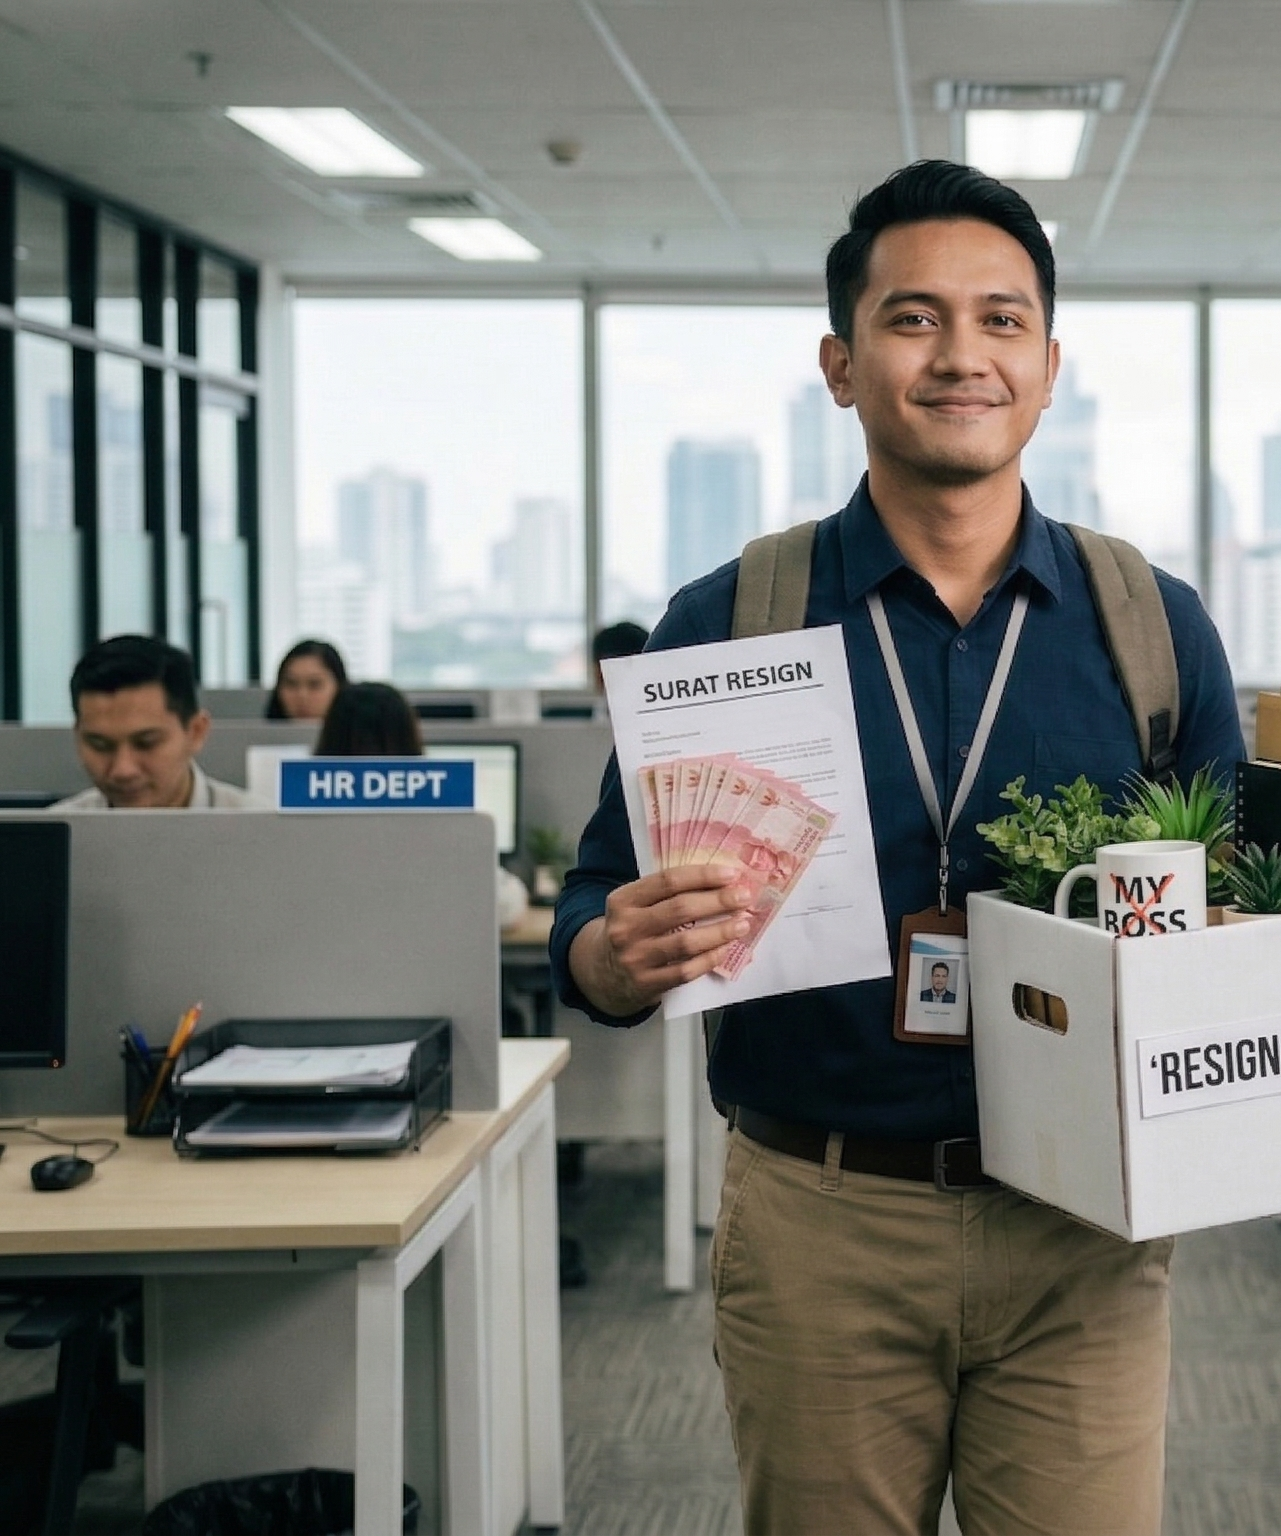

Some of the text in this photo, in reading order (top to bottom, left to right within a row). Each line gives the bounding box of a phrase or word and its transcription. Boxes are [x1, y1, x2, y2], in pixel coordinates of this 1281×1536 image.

[643, 661, 813, 703] SURAT RESIGN
[309, 770, 447, 799] HR DEPT
[1115, 875, 1171, 904] MY
